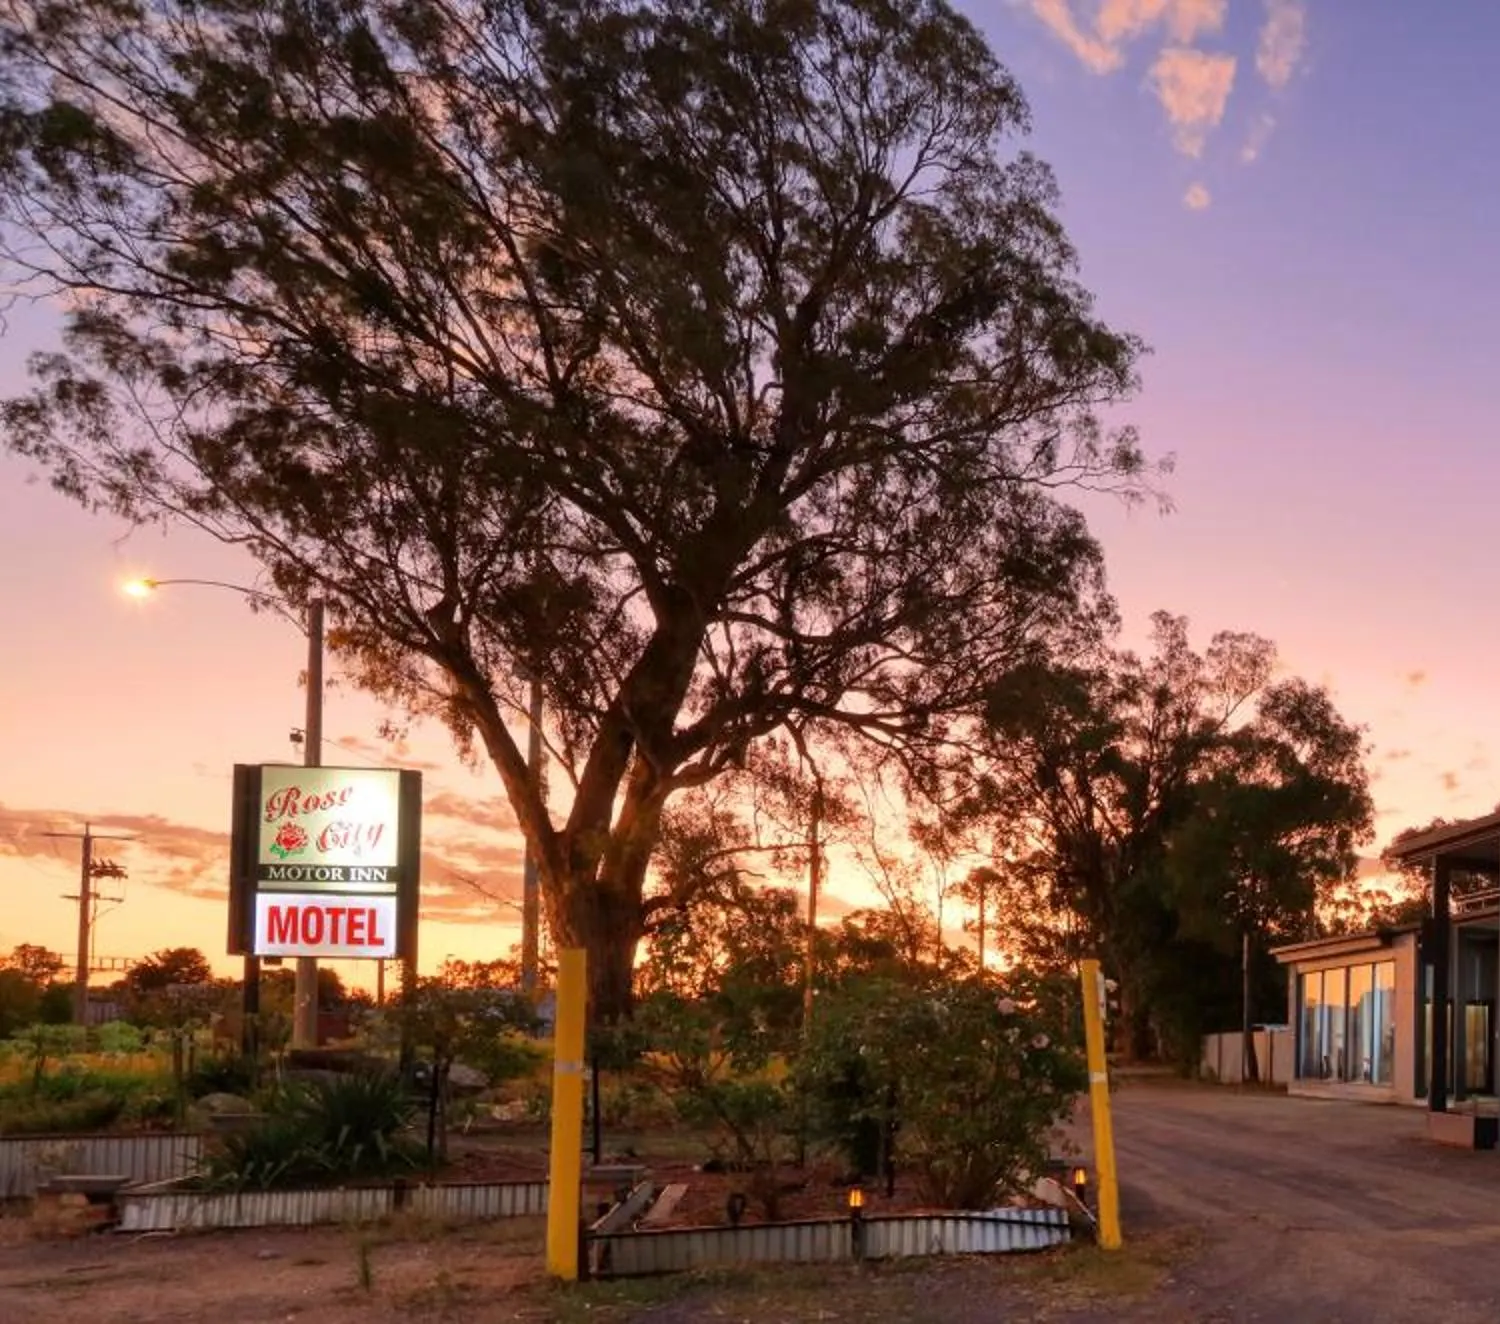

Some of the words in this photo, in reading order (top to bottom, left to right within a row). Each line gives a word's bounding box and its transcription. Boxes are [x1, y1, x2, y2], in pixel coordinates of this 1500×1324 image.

[264, 785, 353, 823] Rose
[316, 820, 385, 858] City
[268, 866, 344, 882] MOTOR
[349, 867, 388, 882] INN
[266, 905, 385, 946] MOTEL
